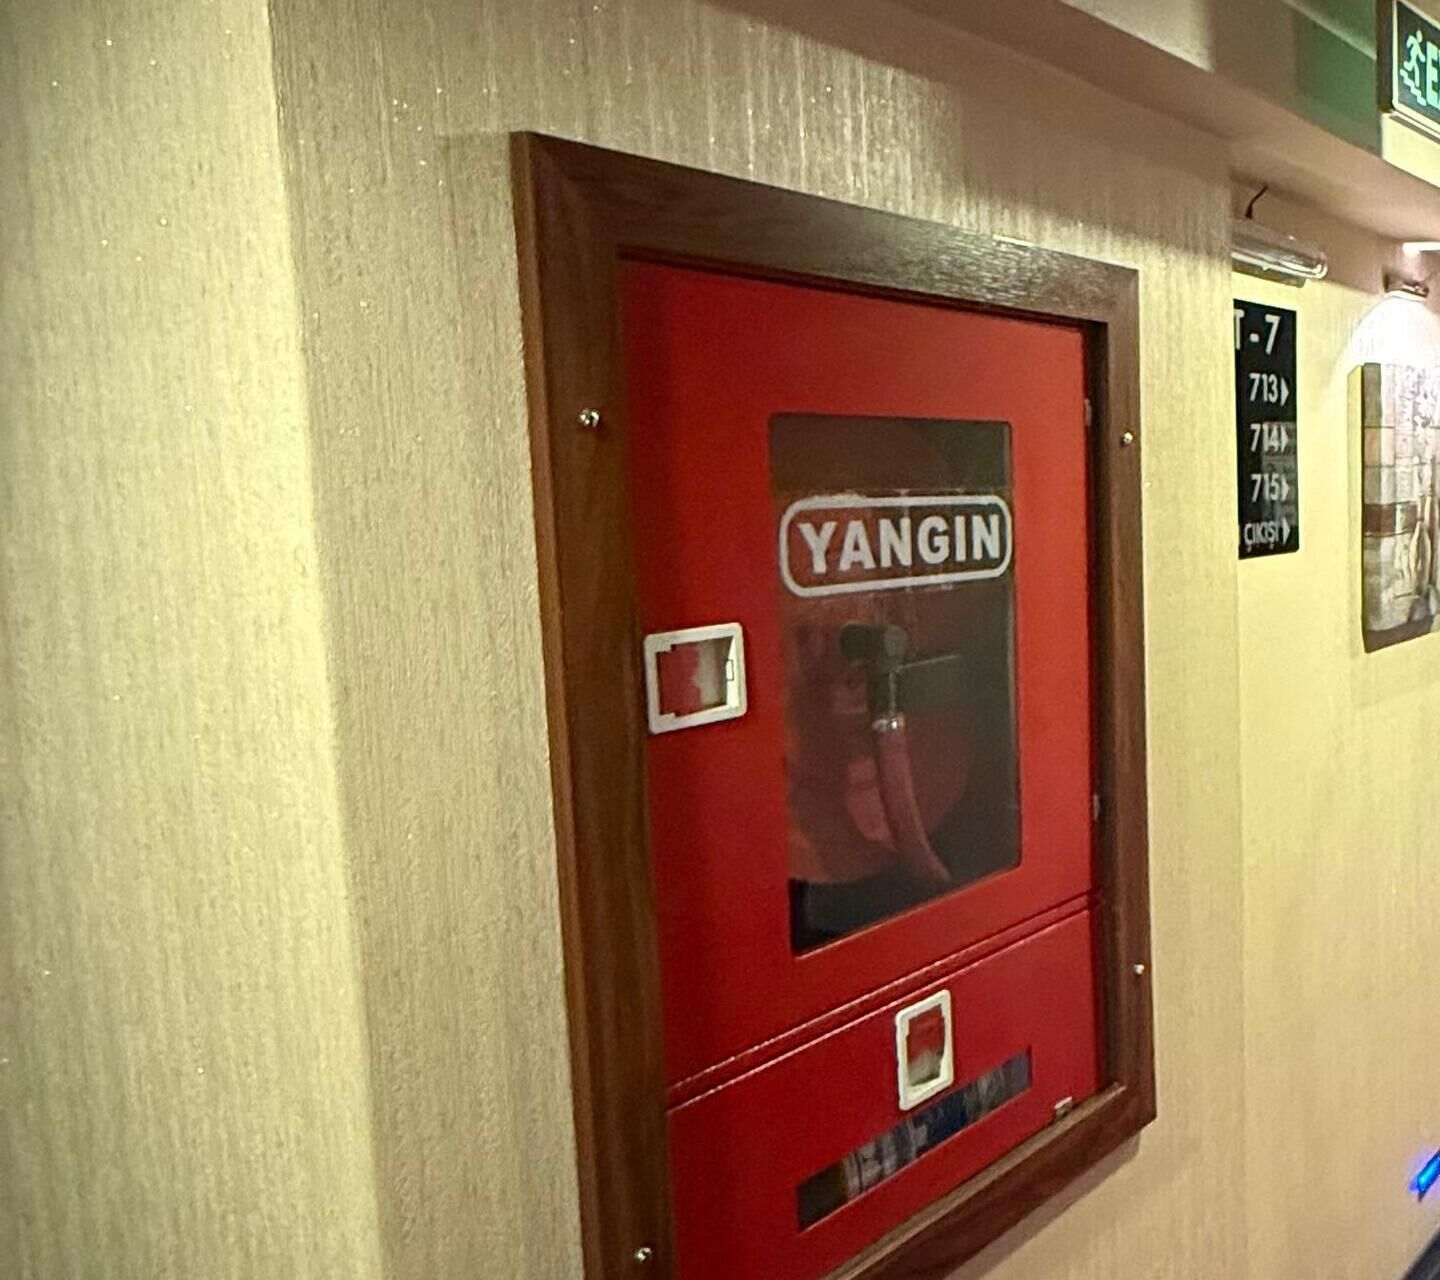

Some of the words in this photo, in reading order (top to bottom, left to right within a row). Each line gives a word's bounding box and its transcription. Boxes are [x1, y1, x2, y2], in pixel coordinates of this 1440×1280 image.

[1265, 314, 1281, 355] 7
[1249, 372, 1279, 403] 713
[1250, 423, 1279, 452] 714
[1250, 473, 1279, 502] 715
[798, 514, 1000, 574] YANGIN
